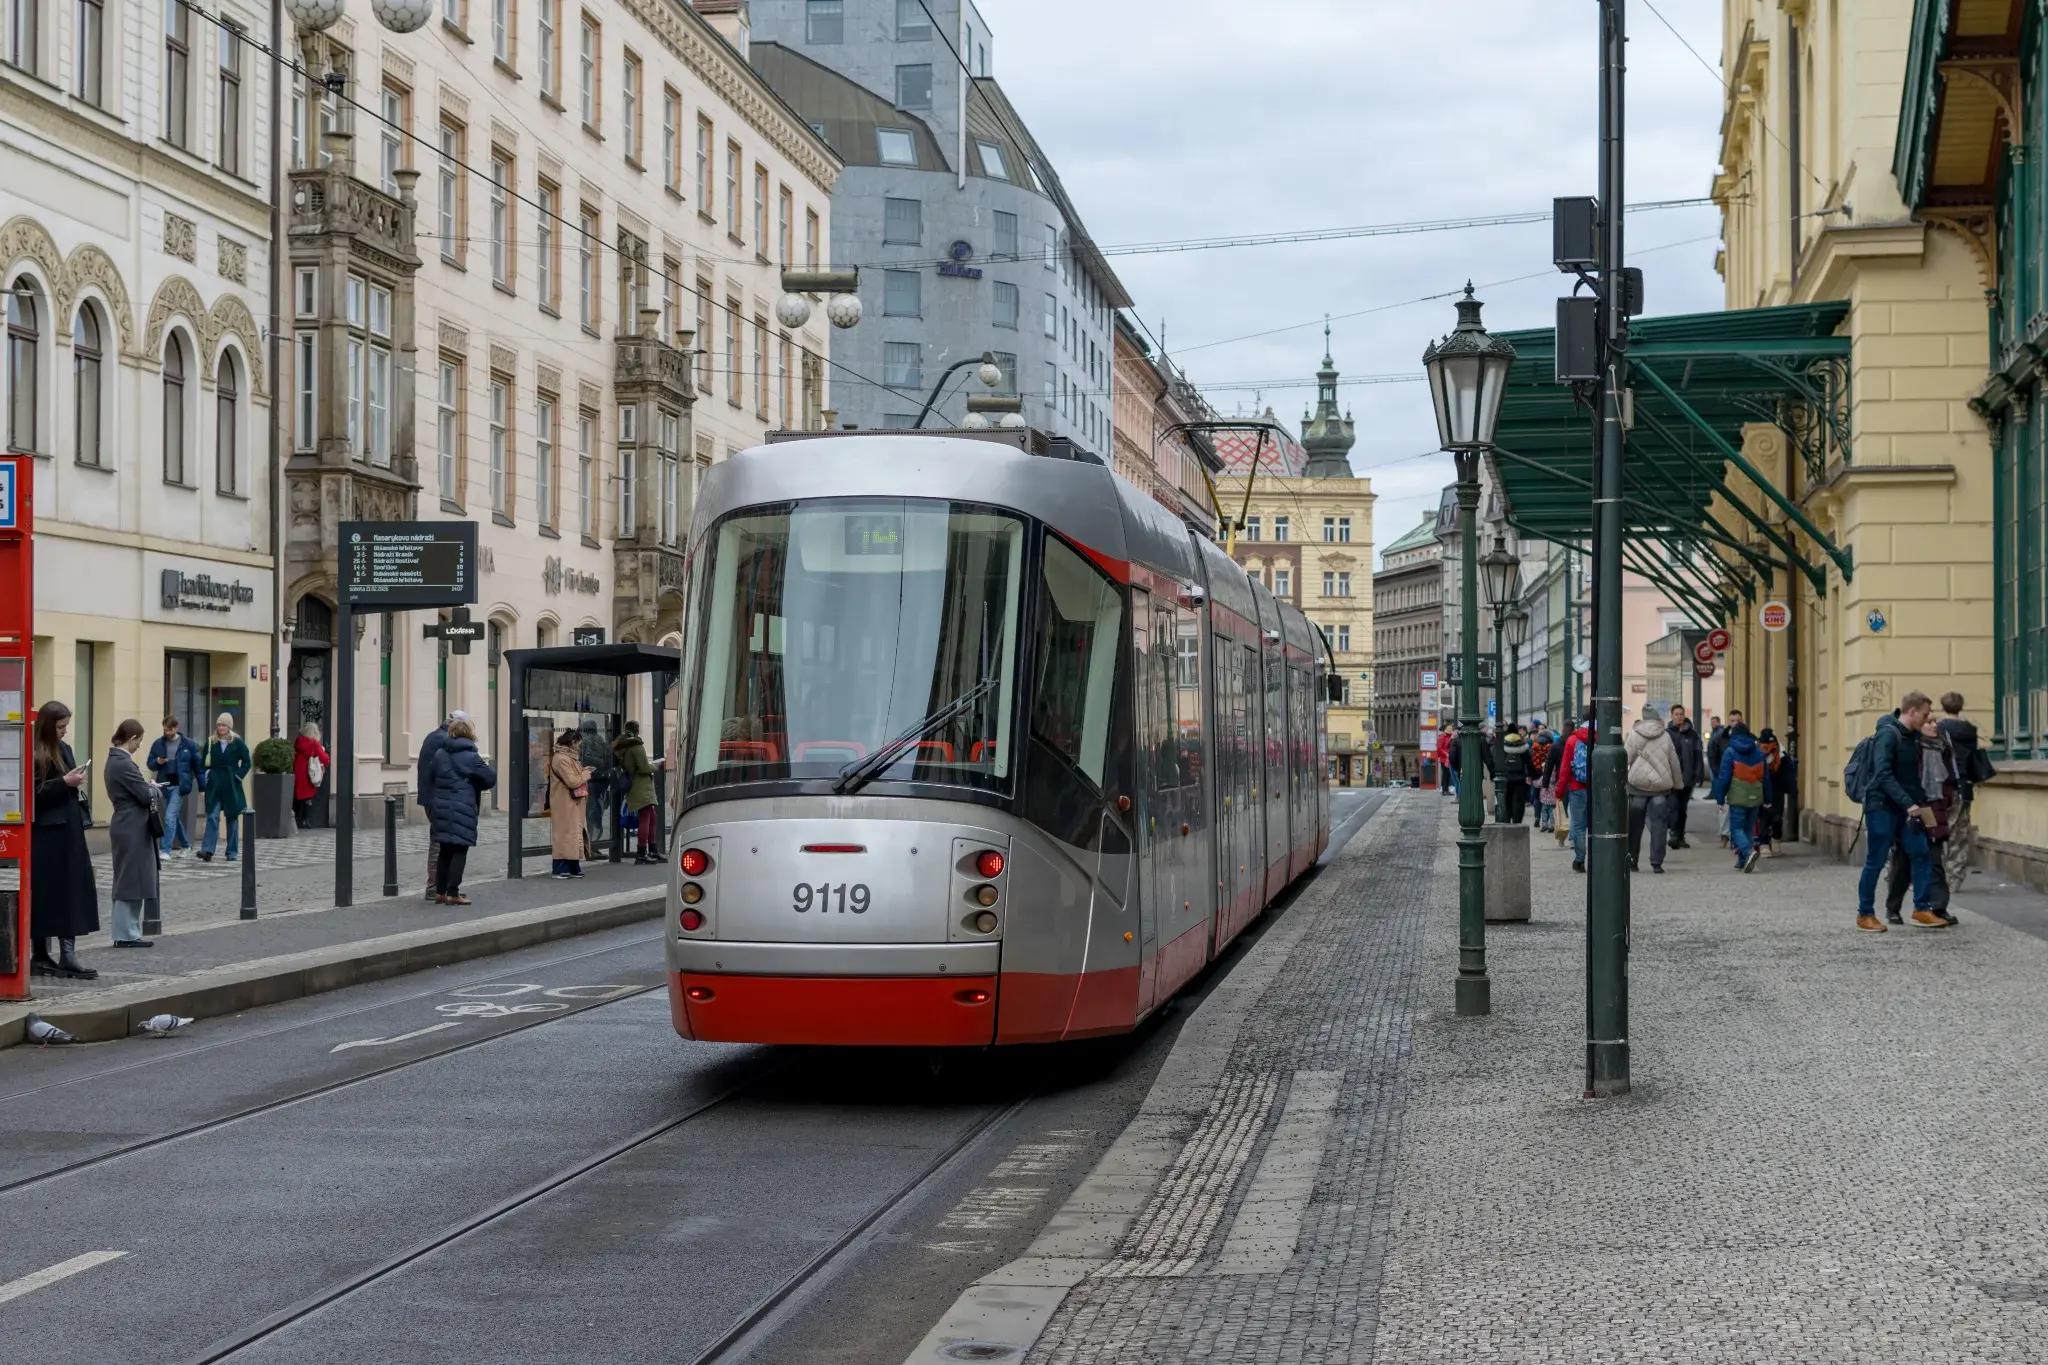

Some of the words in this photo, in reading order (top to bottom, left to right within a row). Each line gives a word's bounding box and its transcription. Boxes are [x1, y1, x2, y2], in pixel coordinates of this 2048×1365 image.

[373, 533, 409, 542] Masarykovo
[410, 533, 435, 542] nádraží
[230, 579, 254, 605] plaza
[445, 626, 475, 635] LÉKÁRNA
[792, 882, 871, 914] 9119
